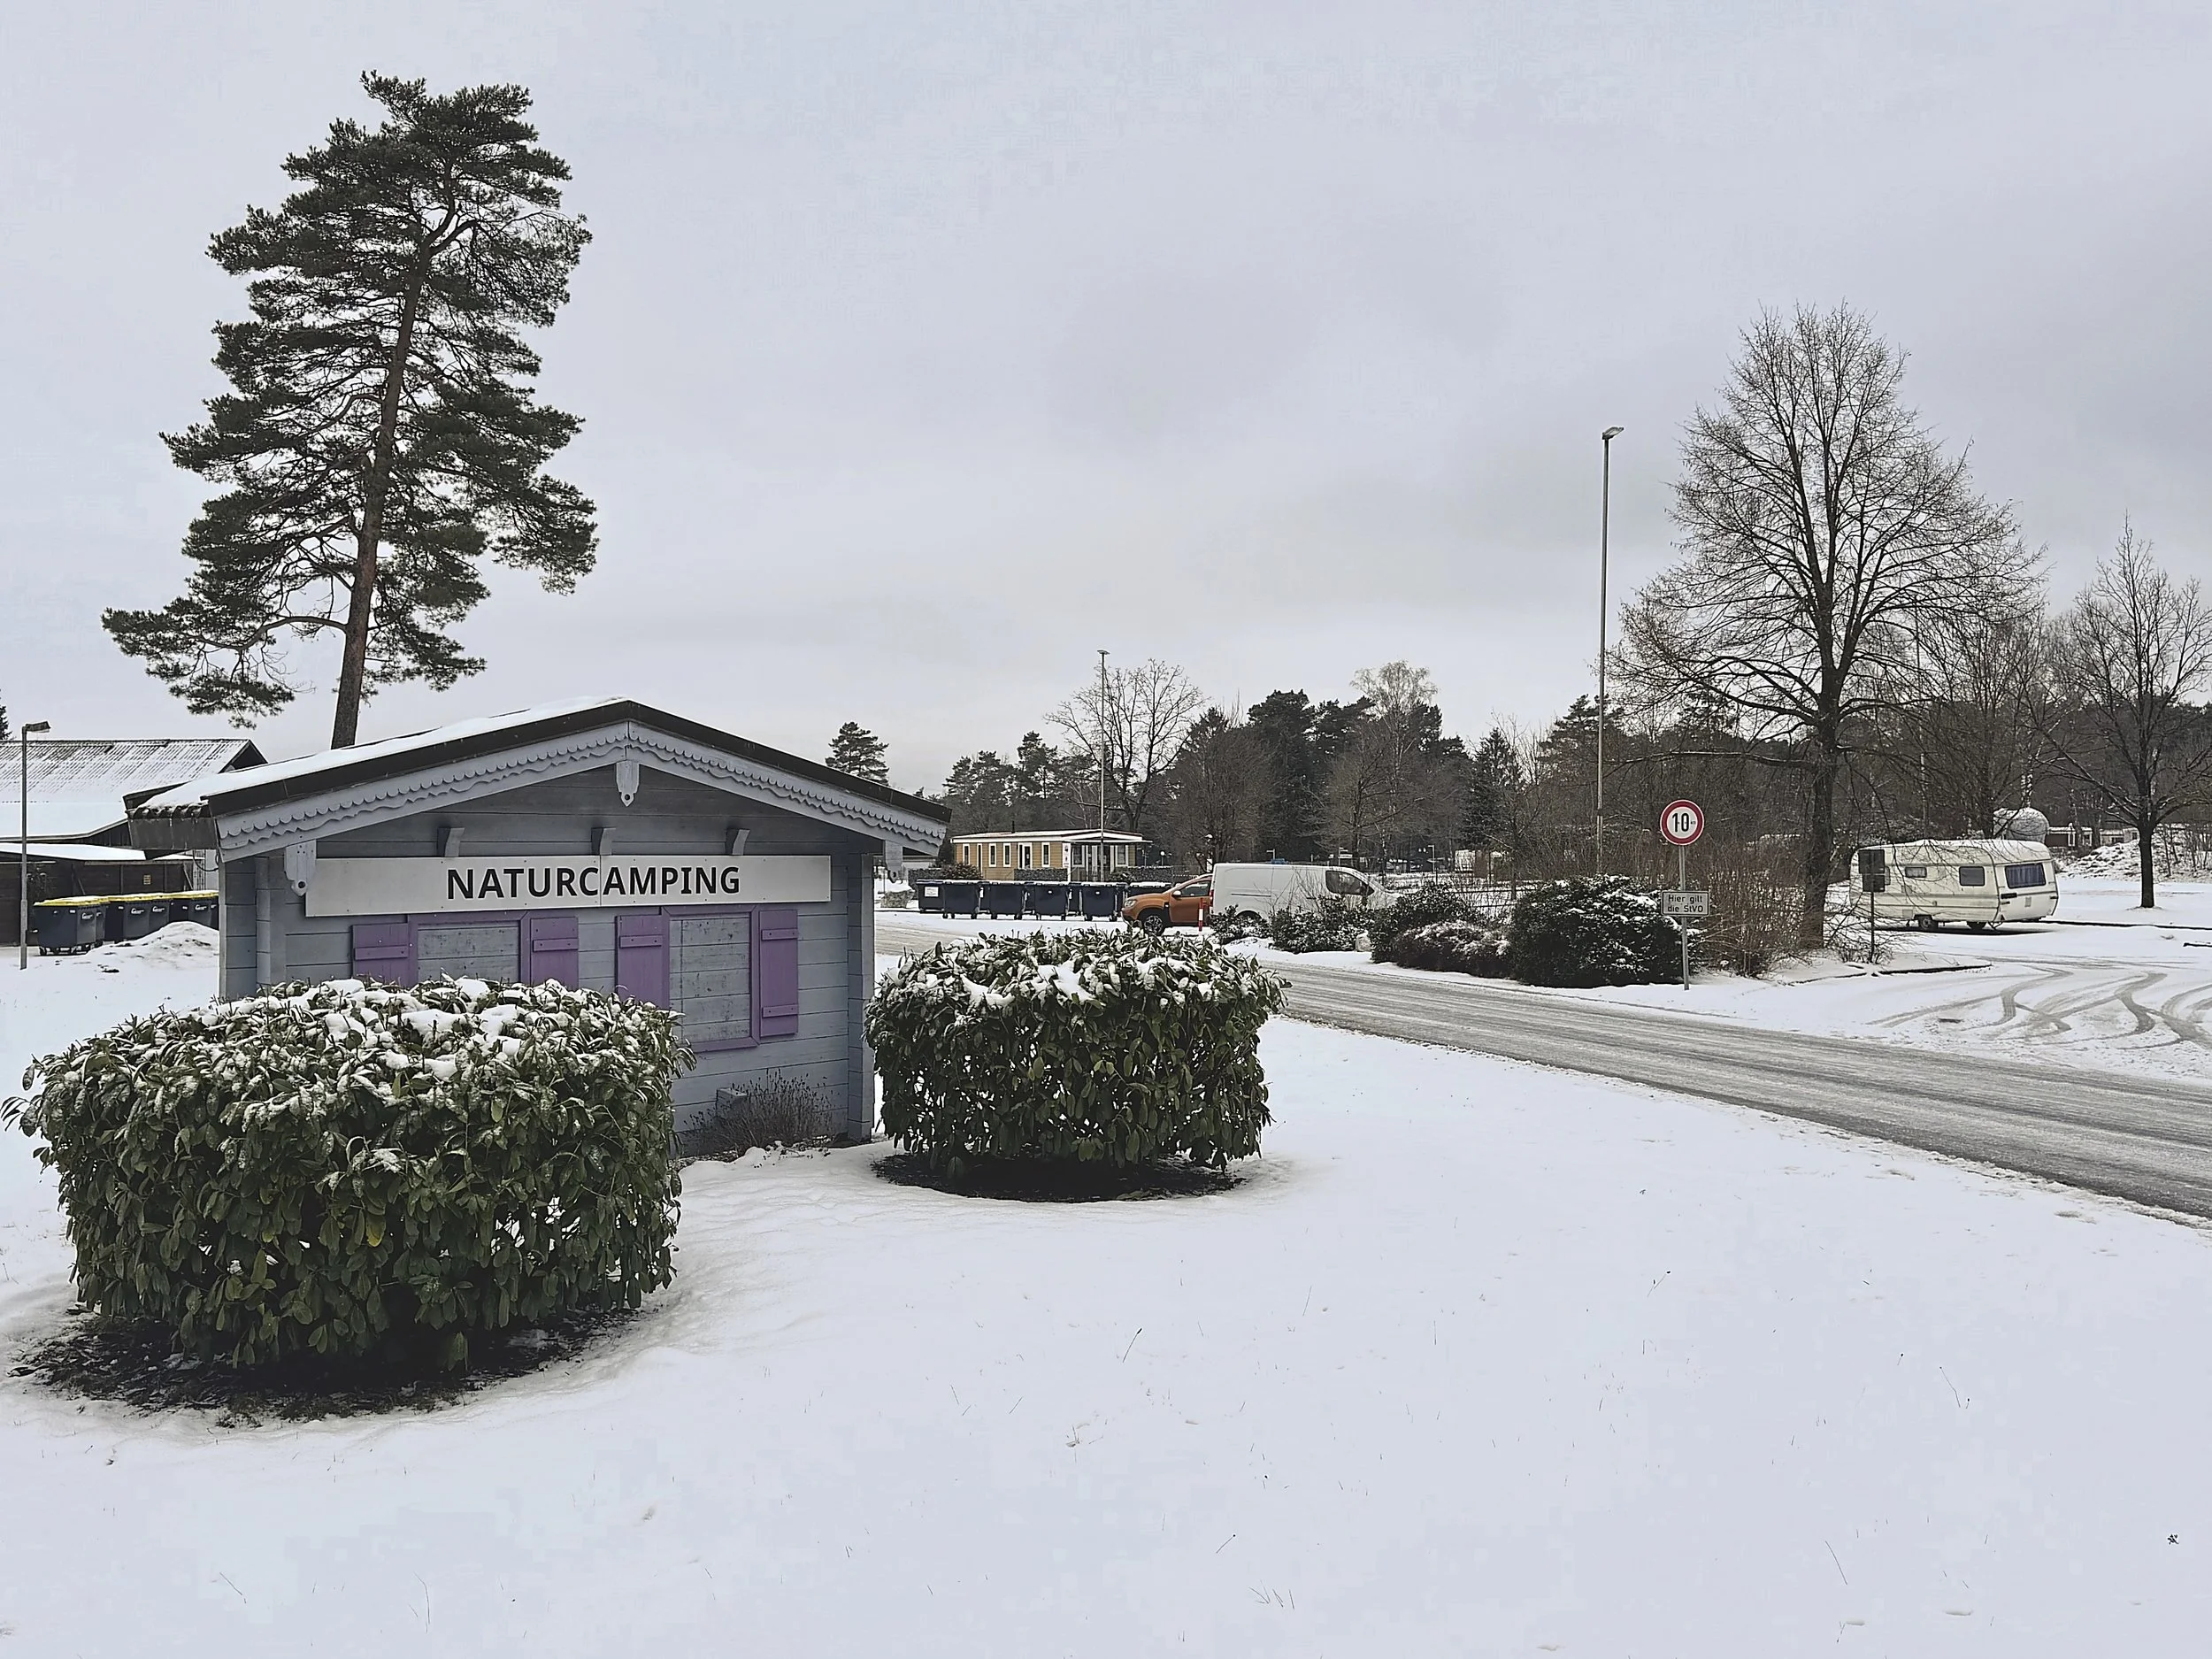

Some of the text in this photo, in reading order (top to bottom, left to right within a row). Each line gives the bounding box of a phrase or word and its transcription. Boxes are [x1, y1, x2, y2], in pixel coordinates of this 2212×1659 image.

[1672, 812, 1689, 832] 10
[447, 867, 740, 899] NATURCAMPING
[1668, 894, 1703, 904] Hier gilt
[1683, 904, 1704, 913] StVO
